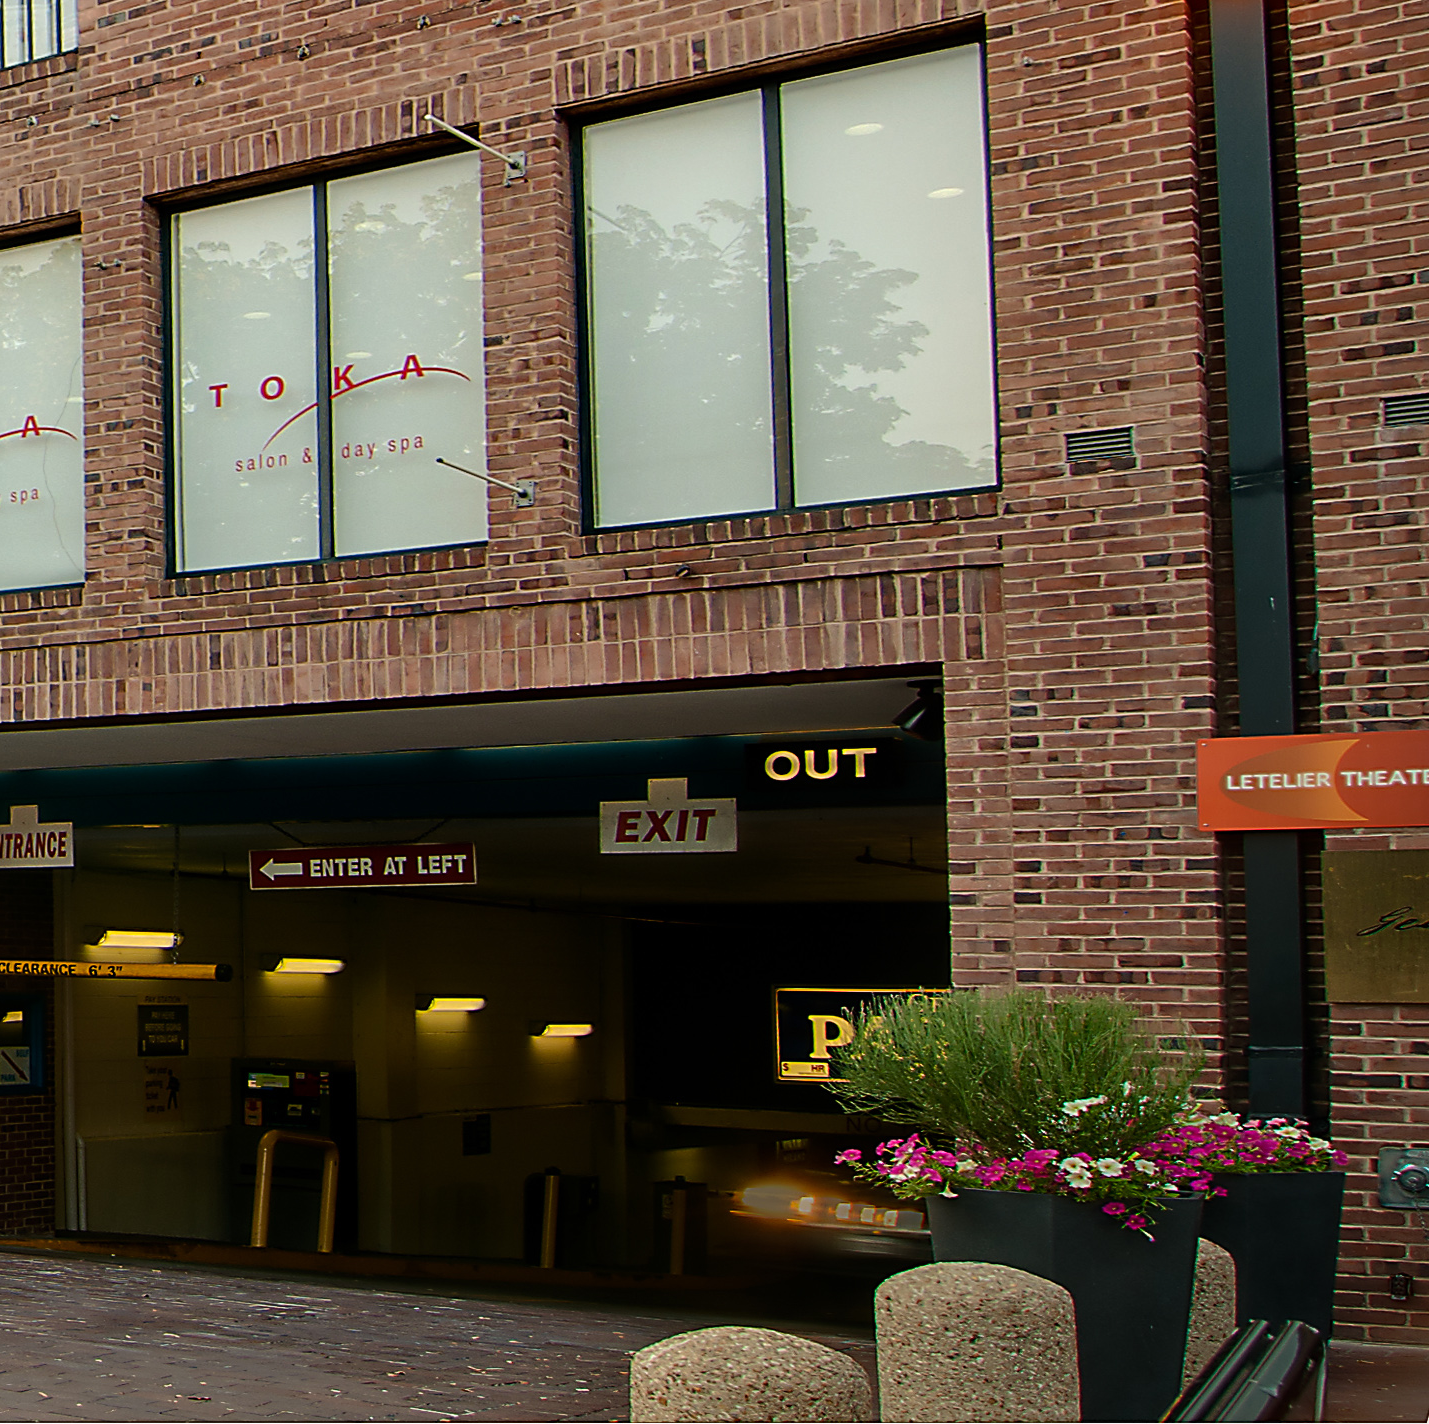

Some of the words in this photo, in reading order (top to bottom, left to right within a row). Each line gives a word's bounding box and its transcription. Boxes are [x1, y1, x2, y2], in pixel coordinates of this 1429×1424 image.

[209, 354, 424, 407] TOKA
[235, 453, 288, 472] salon
[302, 447, 313, 464] &
[341, 441, 376, 459] day
[388, 436, 424, 454] spa
[10, 488, 39, 505] spa
[765, 748, 877, 781] OUT
[1226, 772, 1331, 790] LETELIER
[615, 809, 717, 843] EXIT
[309, 858, 373, 877] ENTER
[384, 856, 407, 875] AT
[417, 854, 467, 874] LEFT
[89, 965, 101, 976] 6'
